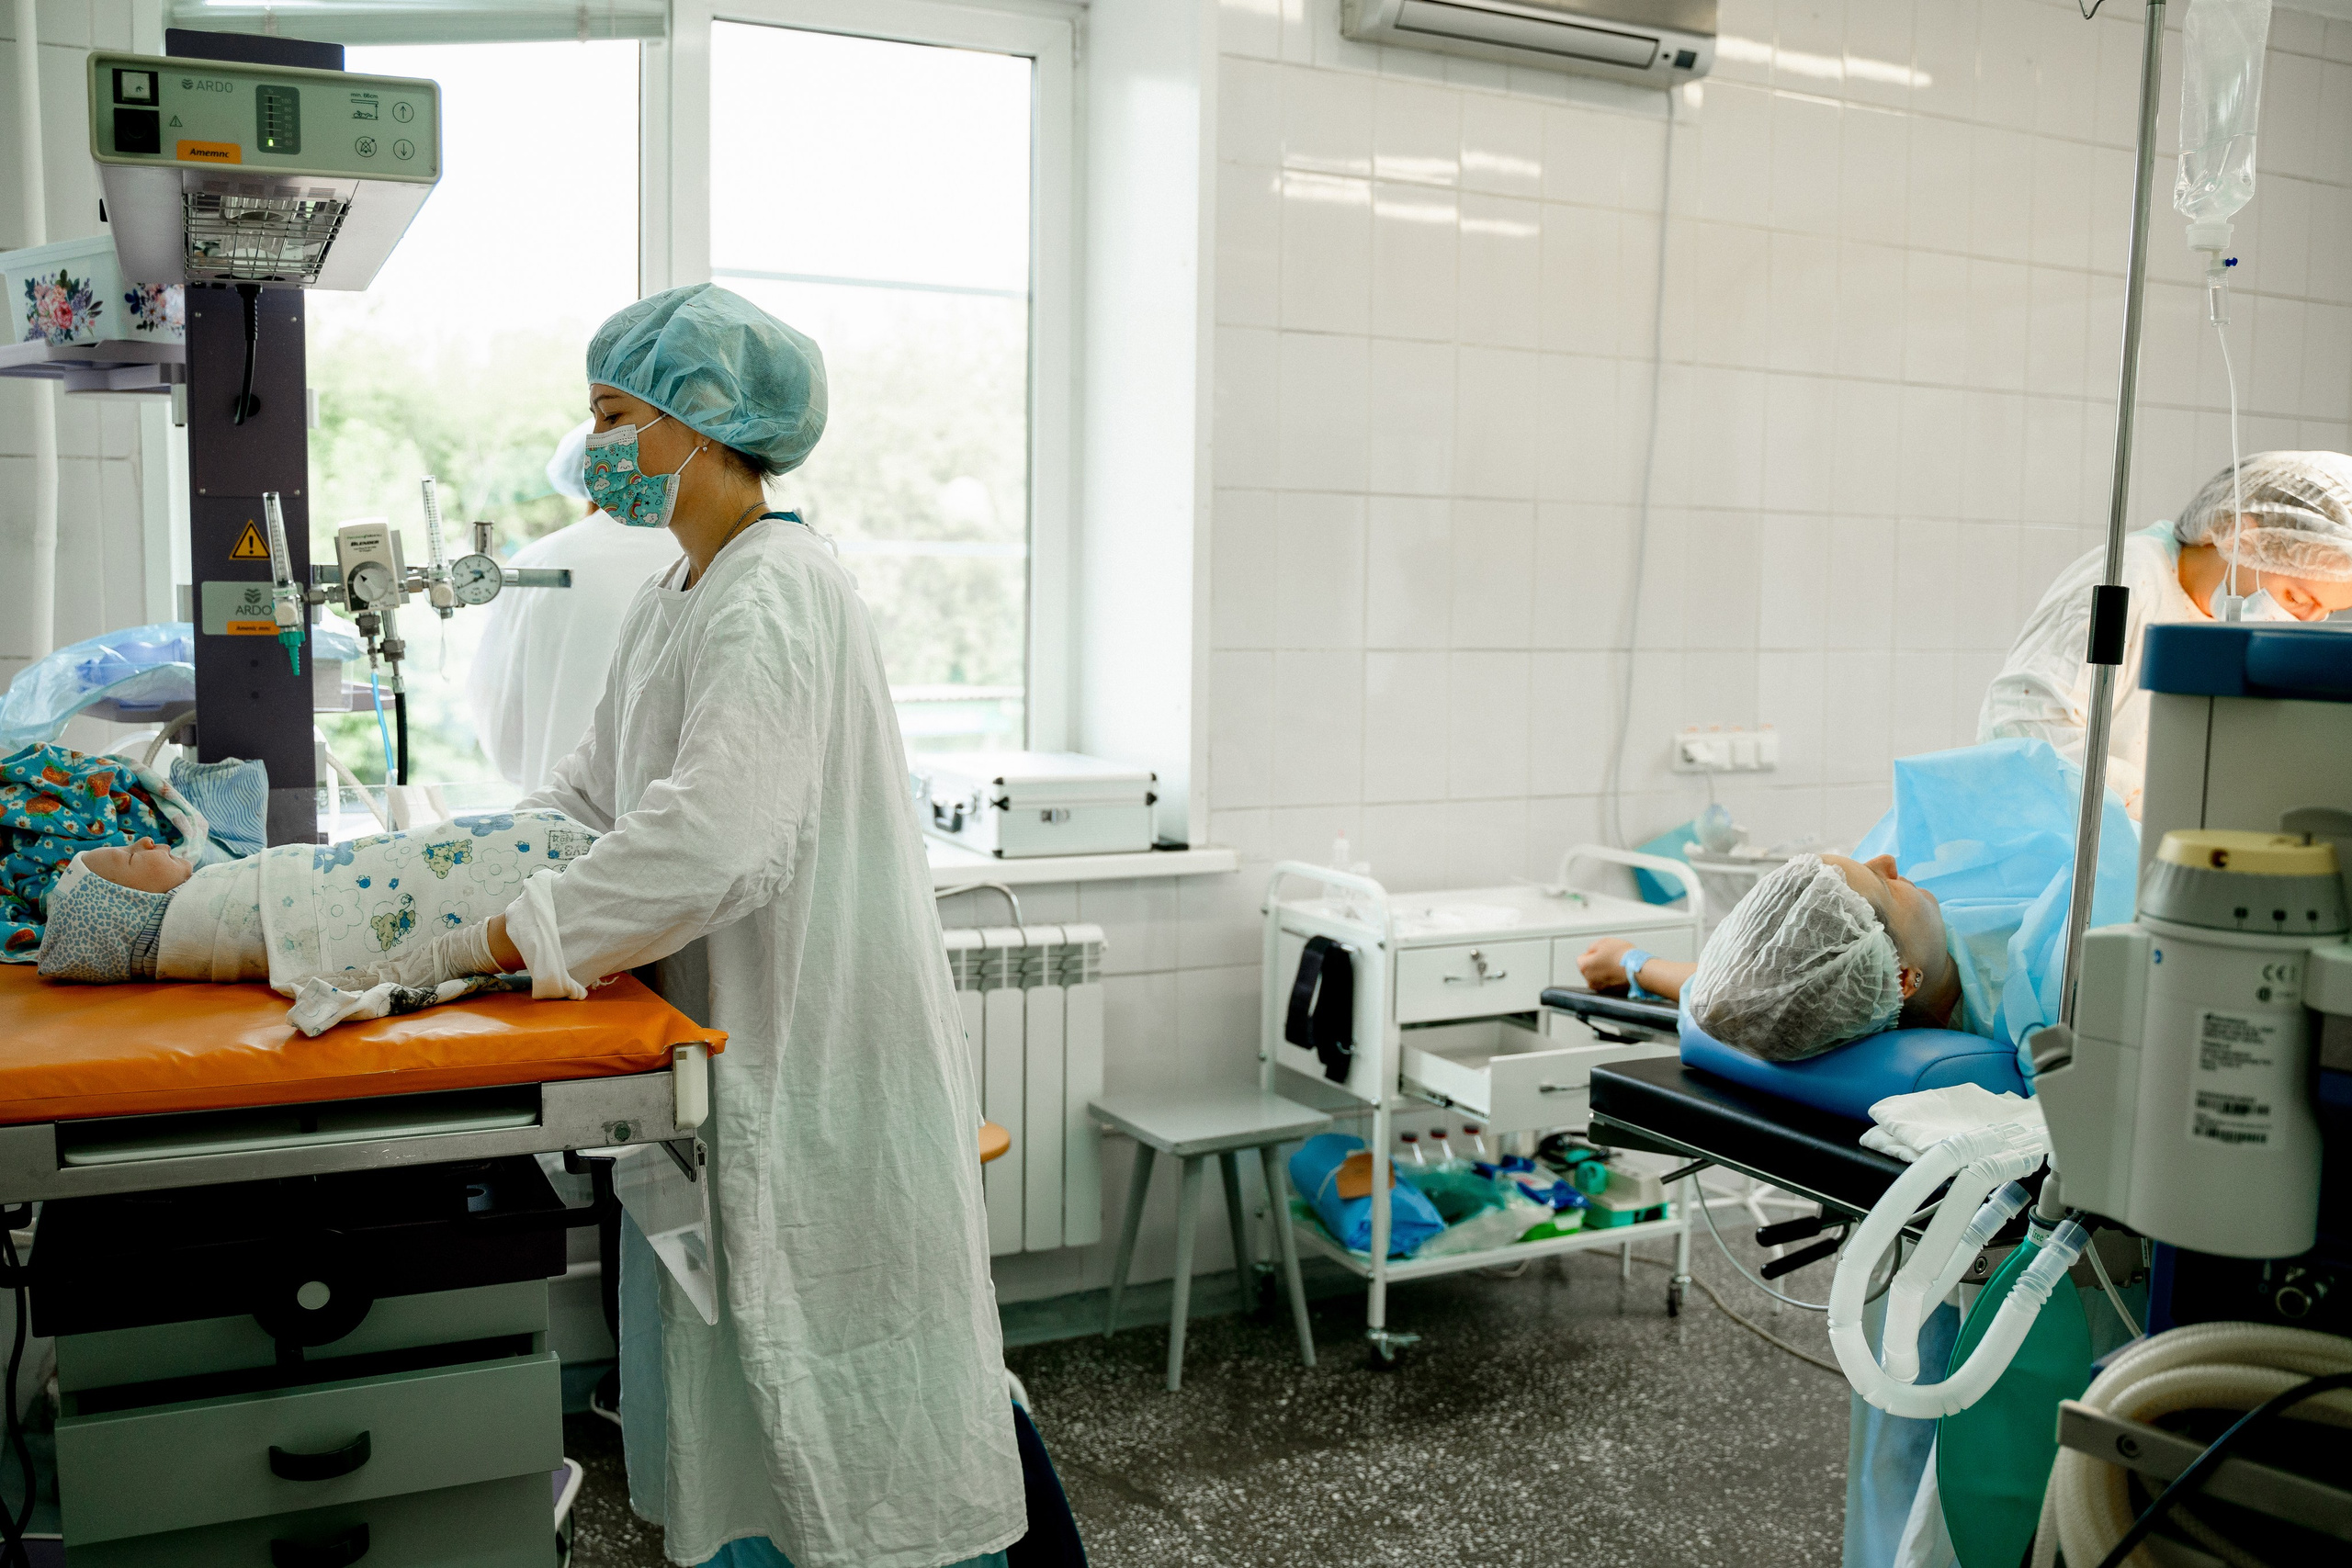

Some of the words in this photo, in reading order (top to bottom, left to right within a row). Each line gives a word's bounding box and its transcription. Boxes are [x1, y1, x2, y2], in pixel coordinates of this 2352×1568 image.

[197, 80, 233, 94] ARDO
[235, 605, 273, 616] ARDO
[2032, 1229, 2044, 1242] free
